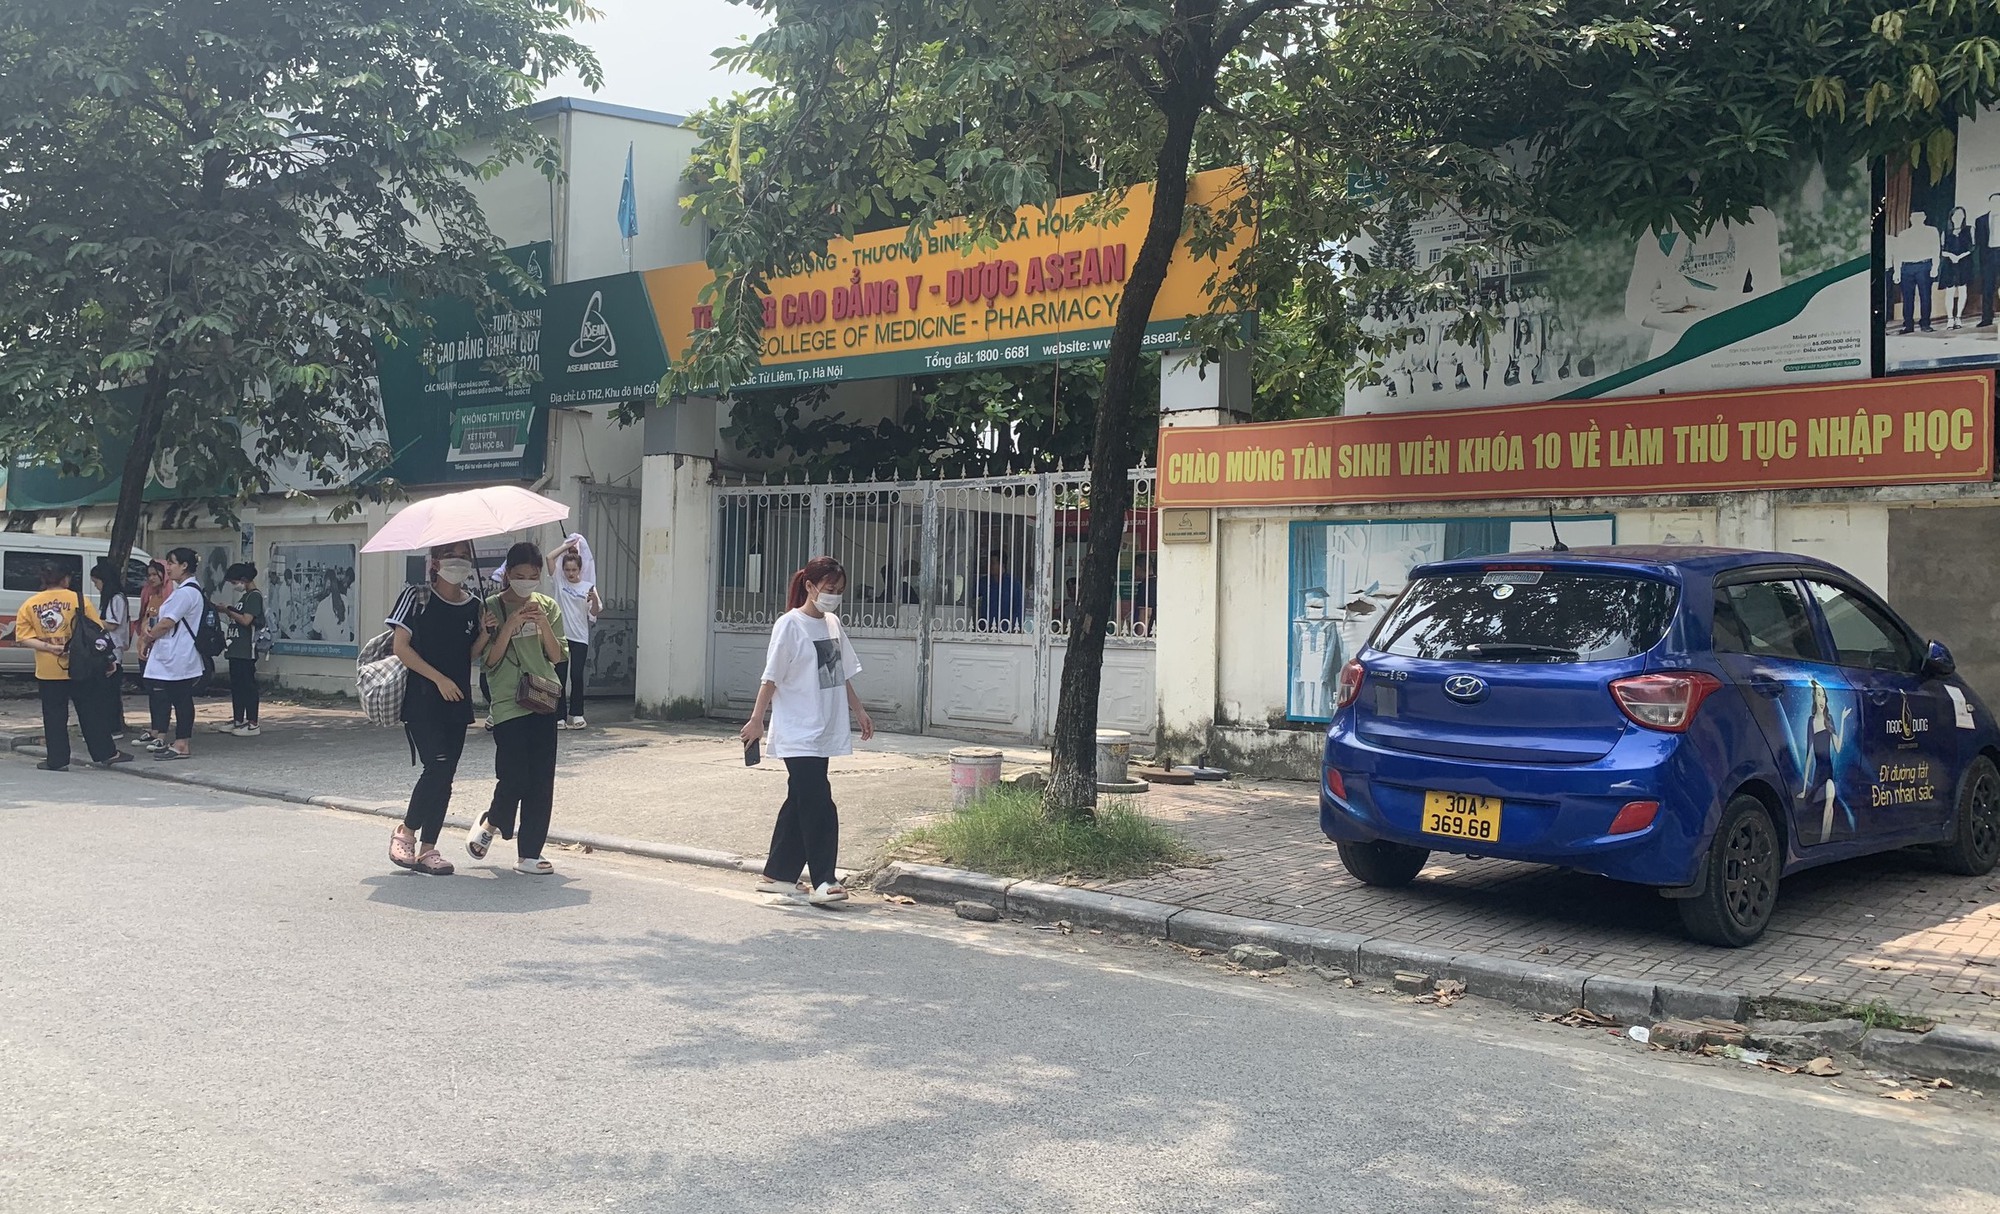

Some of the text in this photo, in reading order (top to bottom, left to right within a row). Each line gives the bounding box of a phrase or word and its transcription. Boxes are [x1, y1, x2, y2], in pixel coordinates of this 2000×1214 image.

[781, 289, 826, 327] CAO
[832, 267, 899, 320] ĐẲNG
[906, 275, 923, 310] Y
[945, 258, 1018, 308] DƯỢC
[1025, 243, 1127, 294] ASEAN
[759, 329, 836, 357] COLLEGE
[843, 325, 869, 348] OF
[875, 313, 967, 345] MEDICINE
[985, 294, 1120, 331] PHARMACY
[437, 341, 455, 363] CAO
[457, 331, 483, 360] ĐẲNG
[925, 351, 952, 368] Tổng
[1042, 340, 1090, 356] website:
[566, 360, 619, 373] ASEAN COLLEGE
[759, 371, 770, 384] Từ
[771, 370, 795, 382] Liêm,
[797, 369, 811, 382] Tp.
[812, 366, 825, 379] Hà
[827, 365, 843, 379] Nội
[424, 381, 458, 392] CÁC NGÀNH
[550, 392, 562, 404] Địa
[576, 390, 586, 400] Lô
[587, 389, 604, 400] TH2,
[605, 387, 620, 398] Khu
[621, 385, 632, 396] đô
[633, 385, 643, 397] thị
[644, 380, 656, 395] Cổ
[461, 408, 526, 424] KHÔNG THI TUYỂN
[467, 430, 497, 441] XÉT TUYỂN
[469, 441, 505, 451] QUA HỌC BẠ
[1168, 407, 1974, 485] CHÀO MỪNG TÂN SINH VIÊN KHÓA 10 VỀ LÀM THỦ TỤC NHẬP HỌC
[1879, 764, 1890, 783] Đi
[1890, 763, 1916, 783] đường
[1872, 779, 1935, 807] Đến nhan sắc
[1445, 795, 1477, 816] 30A
[1430, 814, 1490, 838] 369.68
